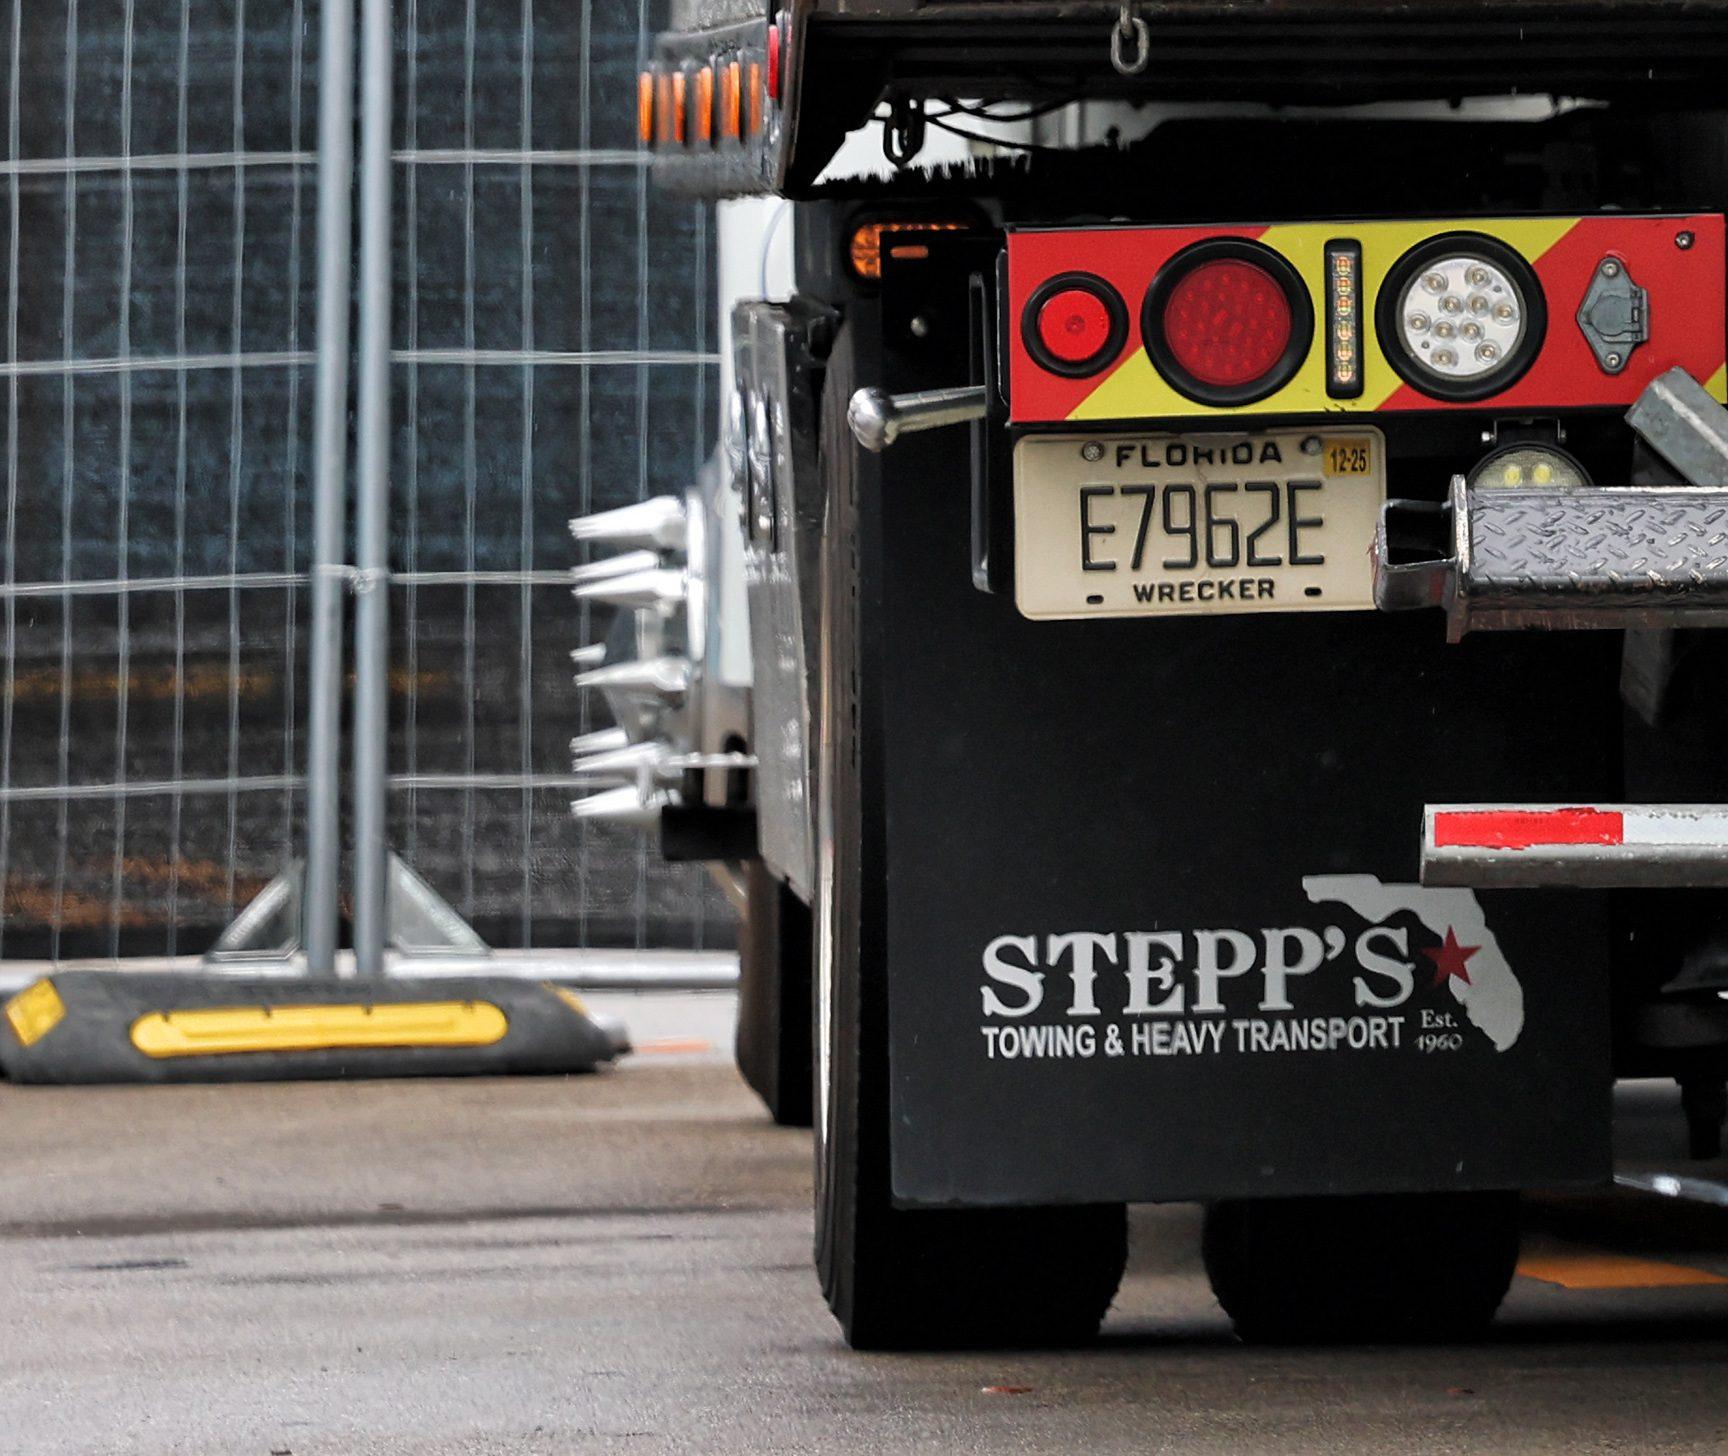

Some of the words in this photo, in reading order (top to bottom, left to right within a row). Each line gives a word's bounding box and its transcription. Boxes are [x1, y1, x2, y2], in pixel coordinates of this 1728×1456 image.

[1114, 442, 1283, 468] FLORIDA
[1079, 480, 1326, 571] E7962E
[1132, 577, 1276, 603] WRECKER
[980, 926, 1415, 1017] STEPP'S
[1420, 1009, 1459, 1029] Est.
[981, 1025, 1096, 1058] TOWING
[1104, 1022, 1125, 1056] &
[1131, 1020, 1227, 1055] HEAVY
[1231, 1016, 1405, 1053] TRANSPORT
[1415, 1033, 1463, 1052] 1960
